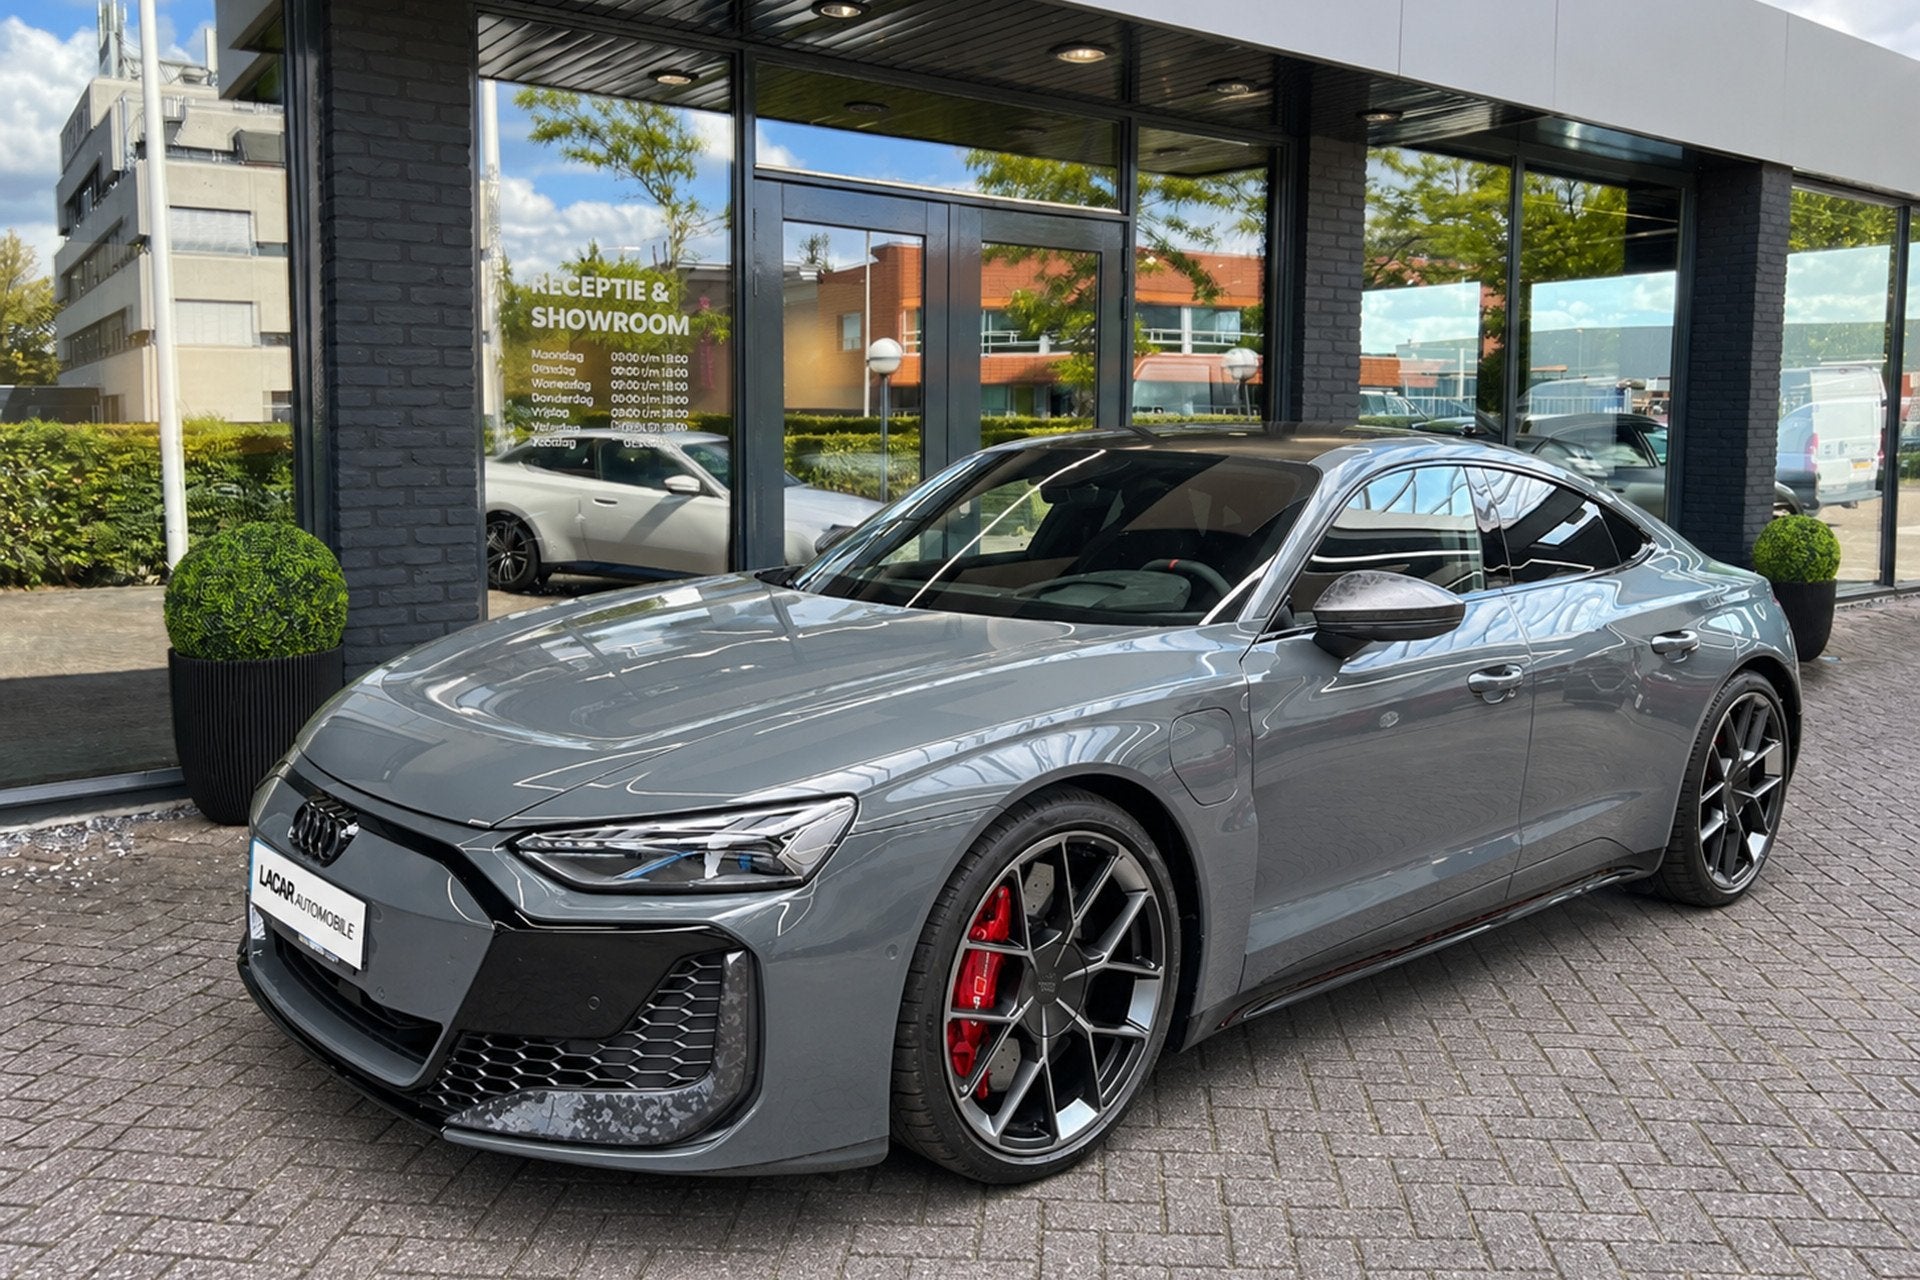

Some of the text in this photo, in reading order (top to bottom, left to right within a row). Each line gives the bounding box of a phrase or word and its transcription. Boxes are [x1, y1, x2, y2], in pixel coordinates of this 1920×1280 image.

[531, 274, 670, 303] RECEPTIE &
[531, 306, 690, 336] SHOWROOM
[259, 864, 355, 940] LACAR AUTOMOBILE
